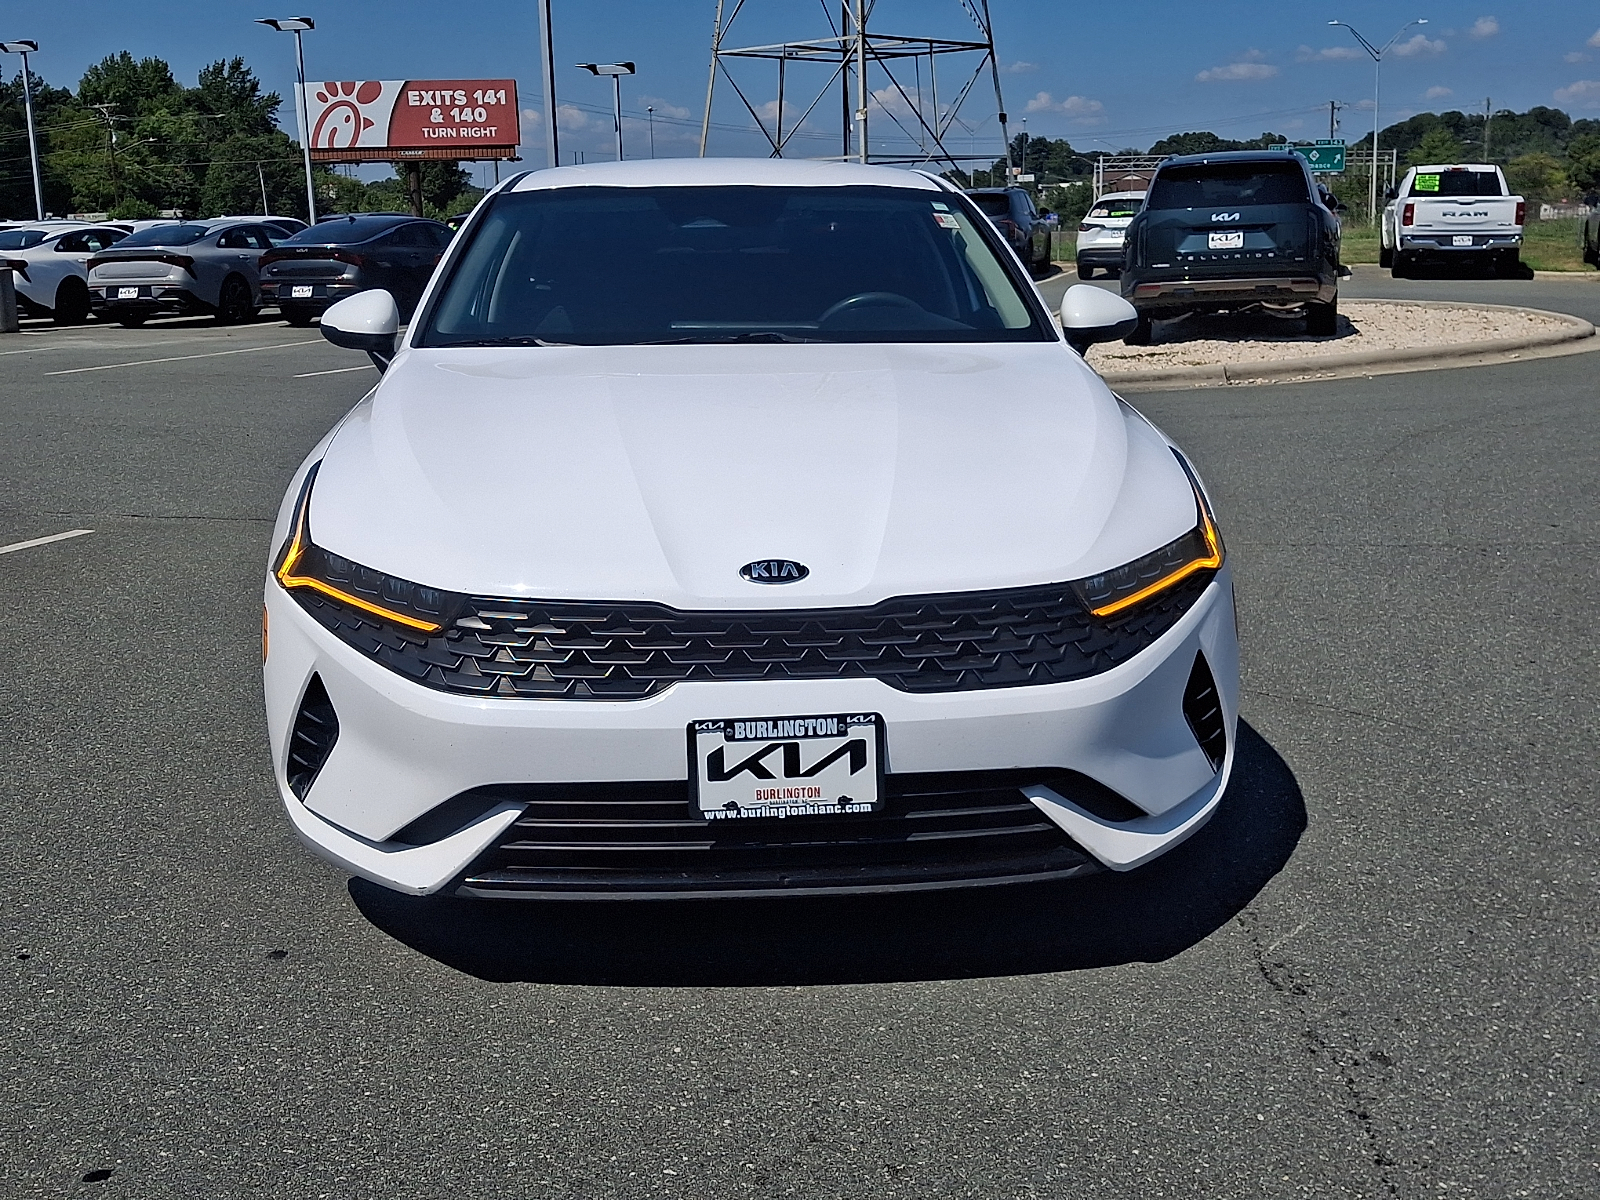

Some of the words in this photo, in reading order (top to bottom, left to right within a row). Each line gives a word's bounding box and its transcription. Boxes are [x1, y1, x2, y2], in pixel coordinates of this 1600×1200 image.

[408, 90, 467, 106] EXITS
[473, 89, 506, 105] 141
[430, 107, 444, 123] &
[450, 107, 487, 123] 140
[422, 127, 457, 138] TURN
[459, 126, 497, 138] RIGHT
[1211, 212, 1240, 222] KIA
[1211, 234, 1241, 242] KIA
[1175, 252, 1275, 261] TELLURIDE
[751, 562, 799, 578] KIA
[695, 721, 725, 730] KIA
[734, 718, 838, 739] BURLINGTON
[846, 714, 876, 723] KIA
[706, 738, 867, 782] KIA
[755, 786, 821, 801] BURLINGTON
[703, 802, 873, 820] www.burlingtonkianc.com
